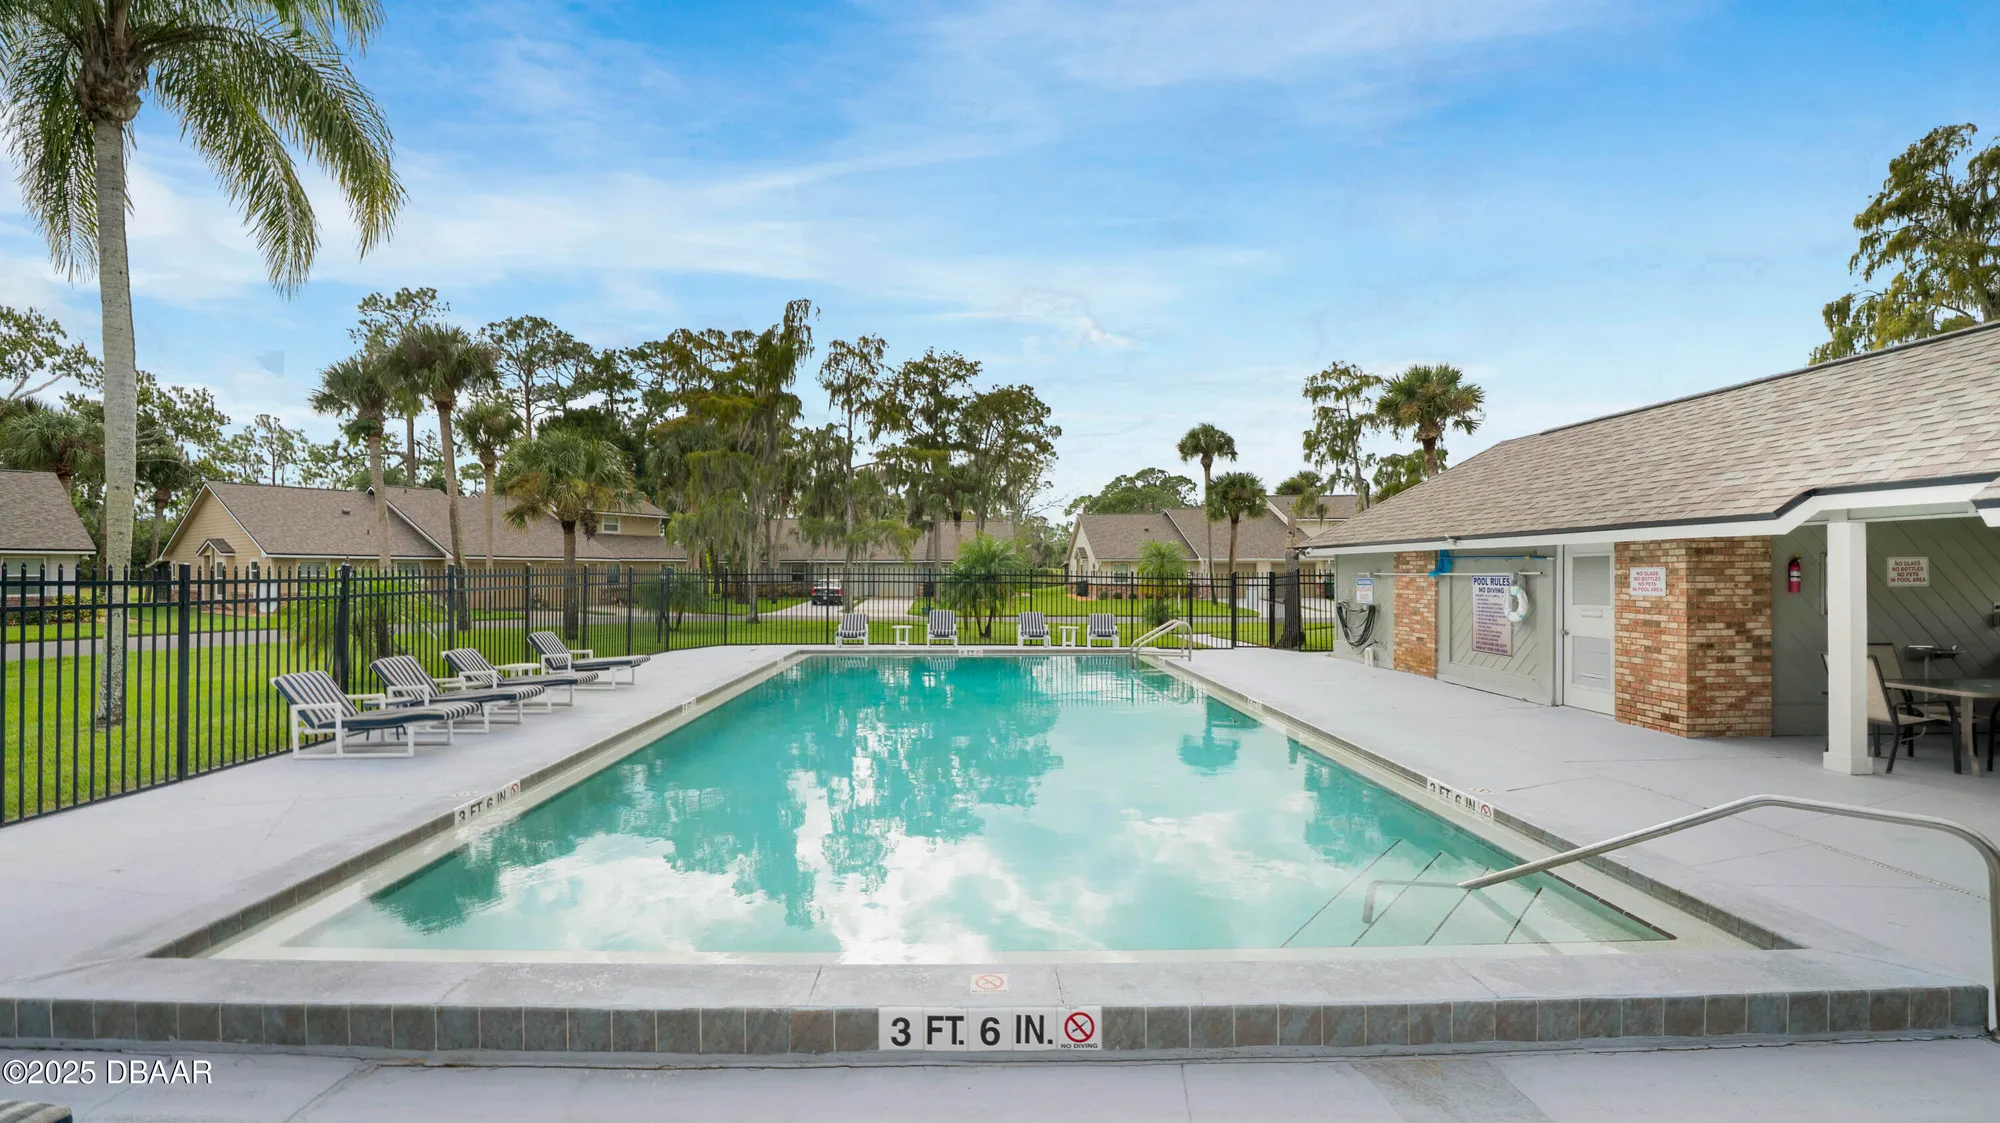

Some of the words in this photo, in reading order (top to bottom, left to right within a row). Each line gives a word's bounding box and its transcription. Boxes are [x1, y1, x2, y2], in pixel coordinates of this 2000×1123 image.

[1474, 577, 1489, 586] POOL
[1490, 577, 1510, 586] RULES
[459, 810, 466, 821] 3
[470, 801, 482, 816] FT
[487, 797, 493, 808] 6
[497, 789, 506, 803] IN
[1440, 785, 1451, 798] FT
[1465, 797, 1476, 811] IN
[890, 1016, 912, 1046] 3
[926, 1015, 964, 1046] FT.
[980, 1016, 1000, 1046] 6
[1016, 1014, 1054, 1045] IN.
